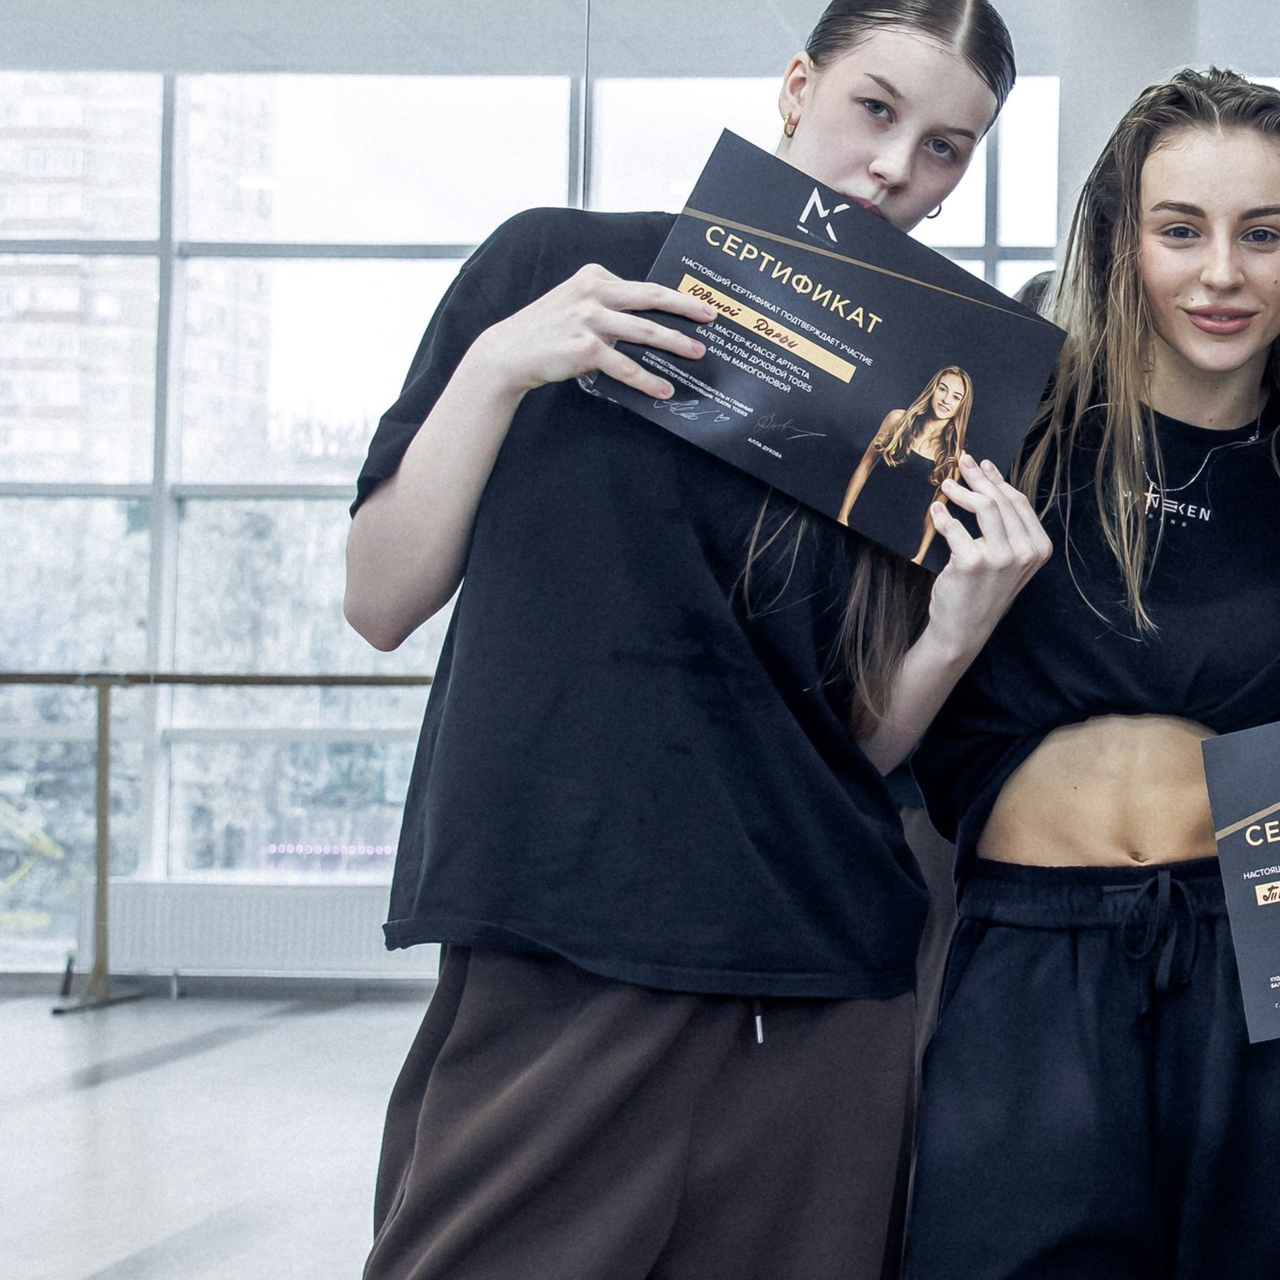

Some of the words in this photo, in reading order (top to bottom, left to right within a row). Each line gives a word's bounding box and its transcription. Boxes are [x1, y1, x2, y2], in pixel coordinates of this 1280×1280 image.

[681, 255, 731, 287] НАСТОЯЩИЙ
[730, 283, 781, 314] СЕРТИФИКАТ
[780, 309, 841, 347] ПОДТВЕРЖДАЕТ
[839, 342, 874, 366] УЧАСТИЕ
[705, 225, 883, 333] СЕРТИФИКАТ
[687, 284, 742, 317] Юдиной
[752, 318, 798, 349] Дарьи
[695, 325, 725, 347] БАЛЕТА
[724, 342, 750, 359] АЛЛЫ
[747, 354, 788, 379] ДУХОВОЙ
[788, 374, 813, 393] TODES
[707, 345, 732, 362] АННЫ
[731, 357, 792, 393] МАКОГОНОВОЙ
[714, 323, 777, 361] МАСТЕР-КЛАССЕ
[775, 357, 810, 380] АРТИСТА
